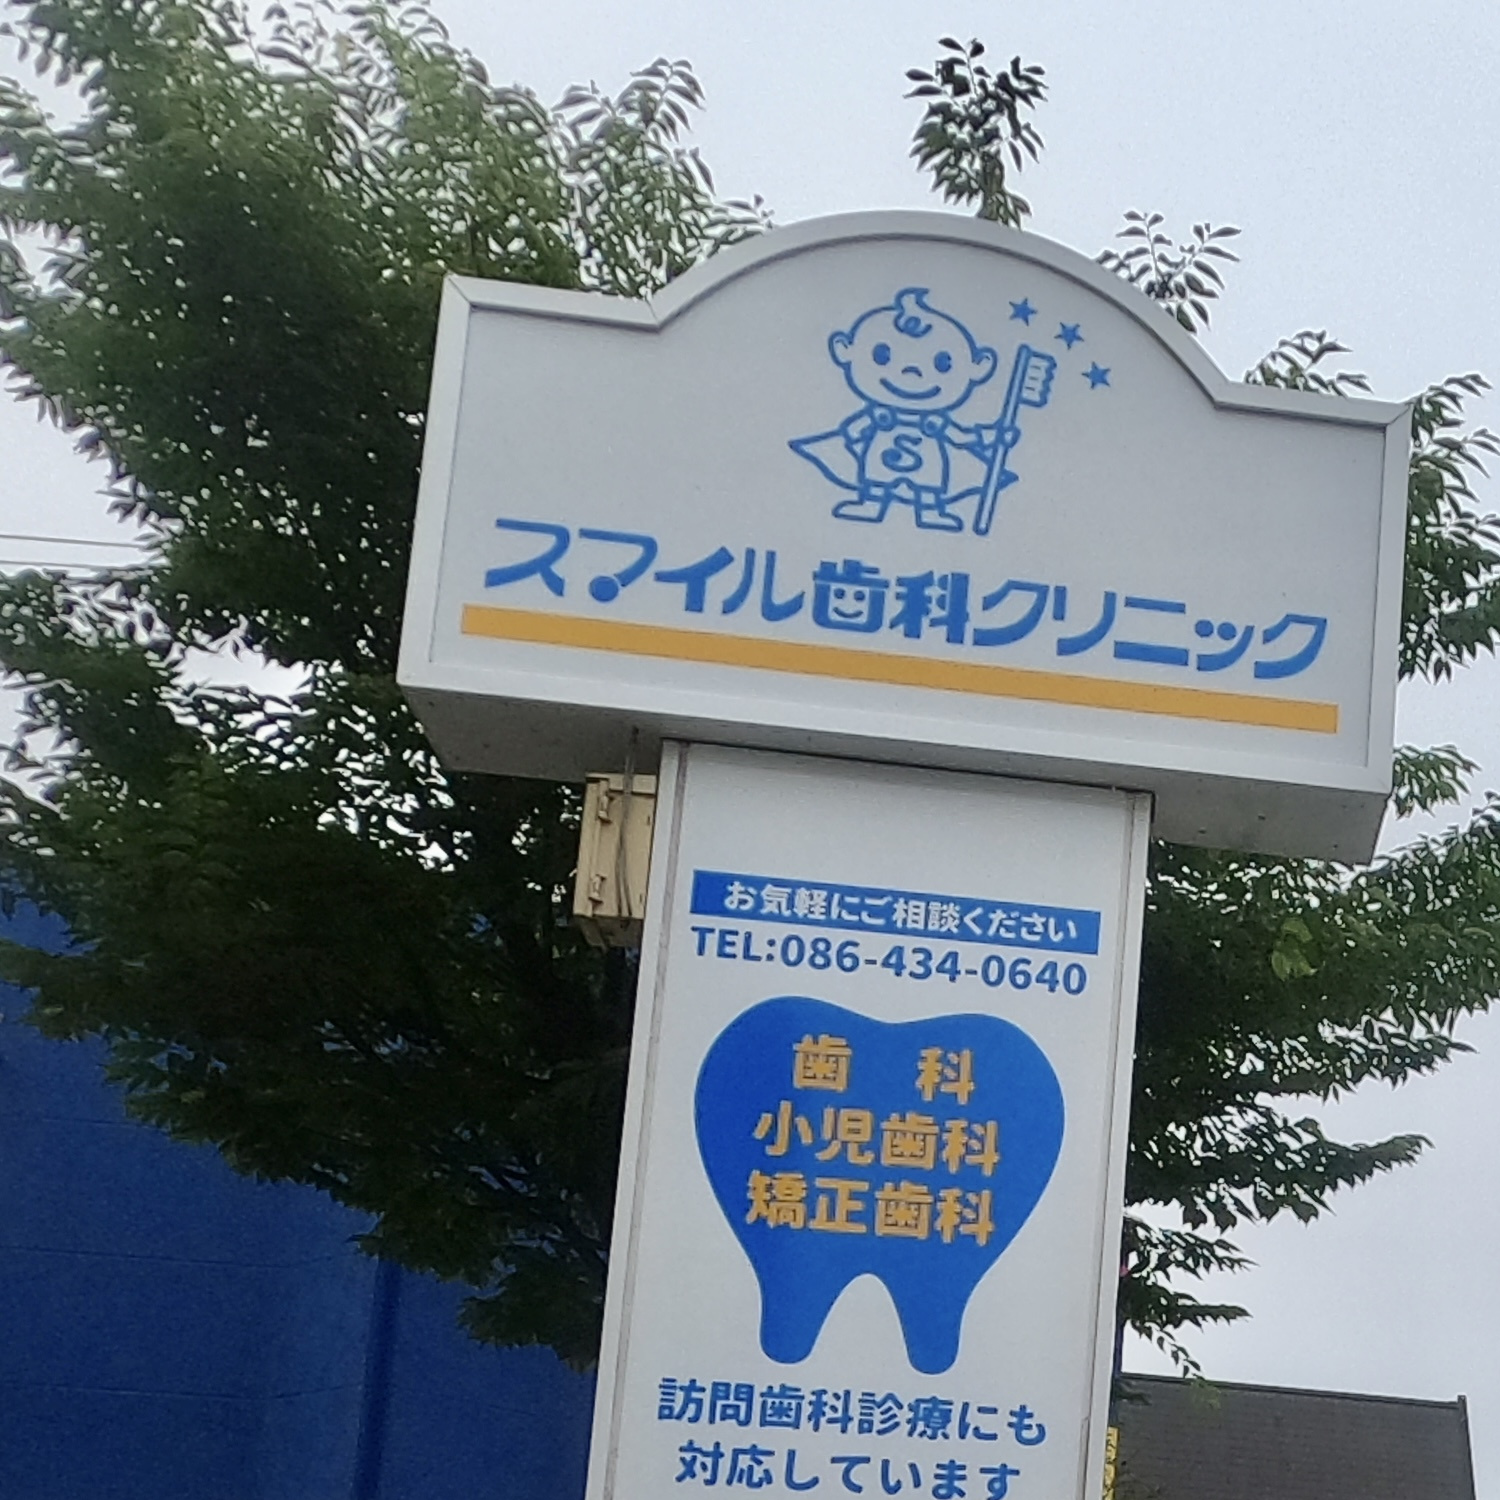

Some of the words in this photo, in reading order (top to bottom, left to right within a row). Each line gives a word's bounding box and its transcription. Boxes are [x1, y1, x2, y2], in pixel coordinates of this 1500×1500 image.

[483, 517, 1327, 680] スマイル歯科クリニック
[723, 880, 1078, 943] お気軽にご相談ください
[690, 925, 1088, 996] TEL:086-434-0640
[751, 1099, 1001, 1178] 小児歯科
[744, 1168, 996, 1247] 矯正歯科
[656, 1376, 1048, 1448] 訪問歯科診療にも
